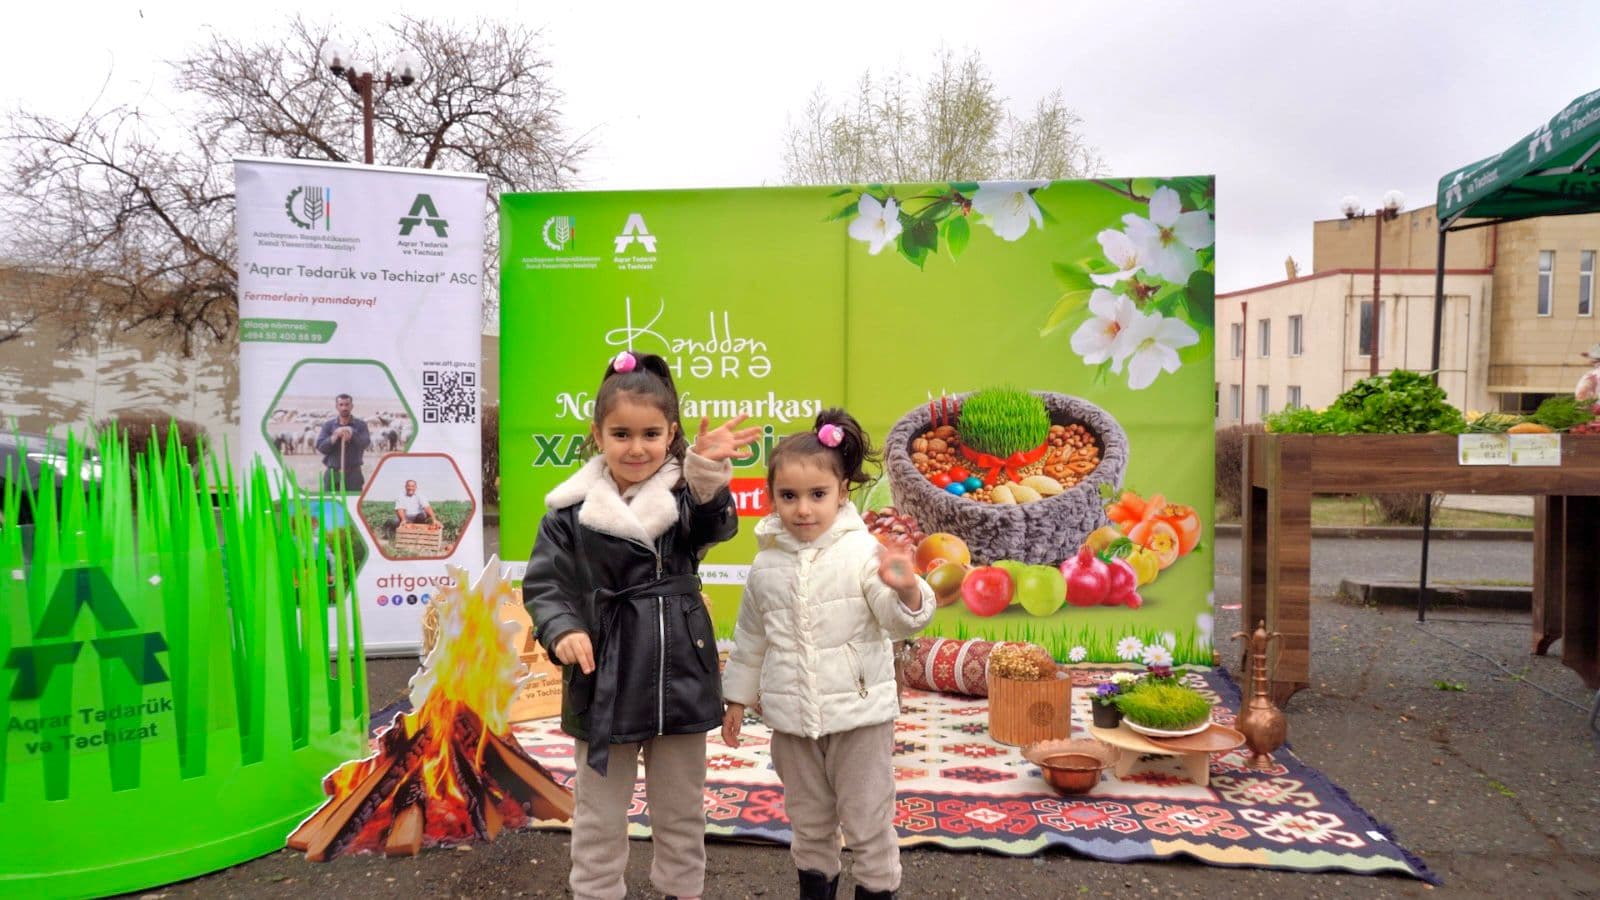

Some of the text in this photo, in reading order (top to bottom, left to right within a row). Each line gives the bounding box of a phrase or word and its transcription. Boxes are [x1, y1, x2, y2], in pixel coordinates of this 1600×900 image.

[297, 265, 356, 280] Tədarük
[360, 271, 377, 280] və
[450, 273, 478, 285] ASC
[605, 296, 767, 353] Kənddən
[677, 391, 823, 424] armarkası
[731, 488, 764, 510] art
[376, 573, 456, 592] attgova
[7, 697, 173, 734] Aqrar Tədarük
[24, 722, 159, 754] və Təchizat
